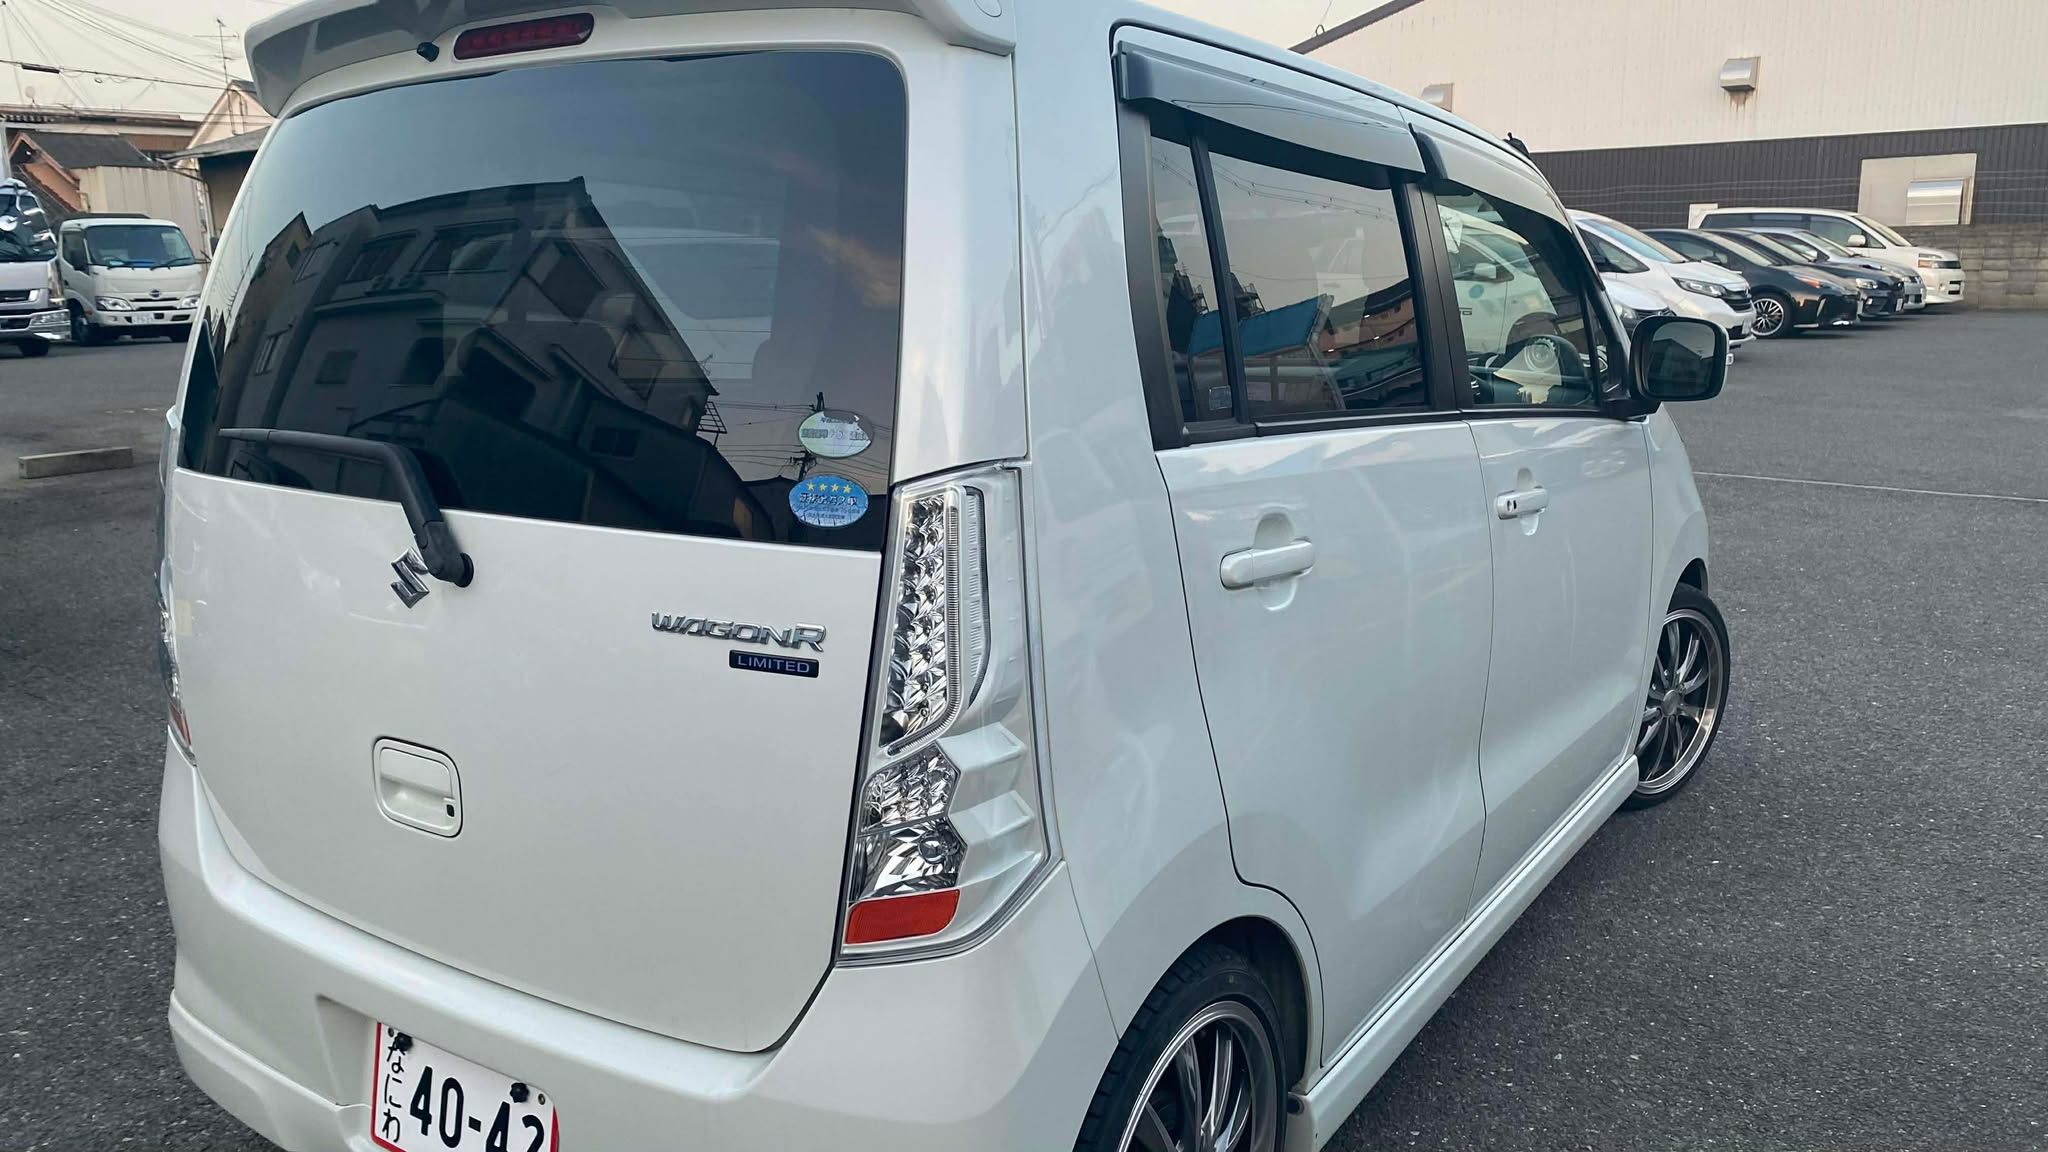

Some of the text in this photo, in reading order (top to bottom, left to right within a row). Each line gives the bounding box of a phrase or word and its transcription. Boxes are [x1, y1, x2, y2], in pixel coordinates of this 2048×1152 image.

[737, 654, 810, 674] LIMITED
[381, 1041, 406, 1143] なにわ
